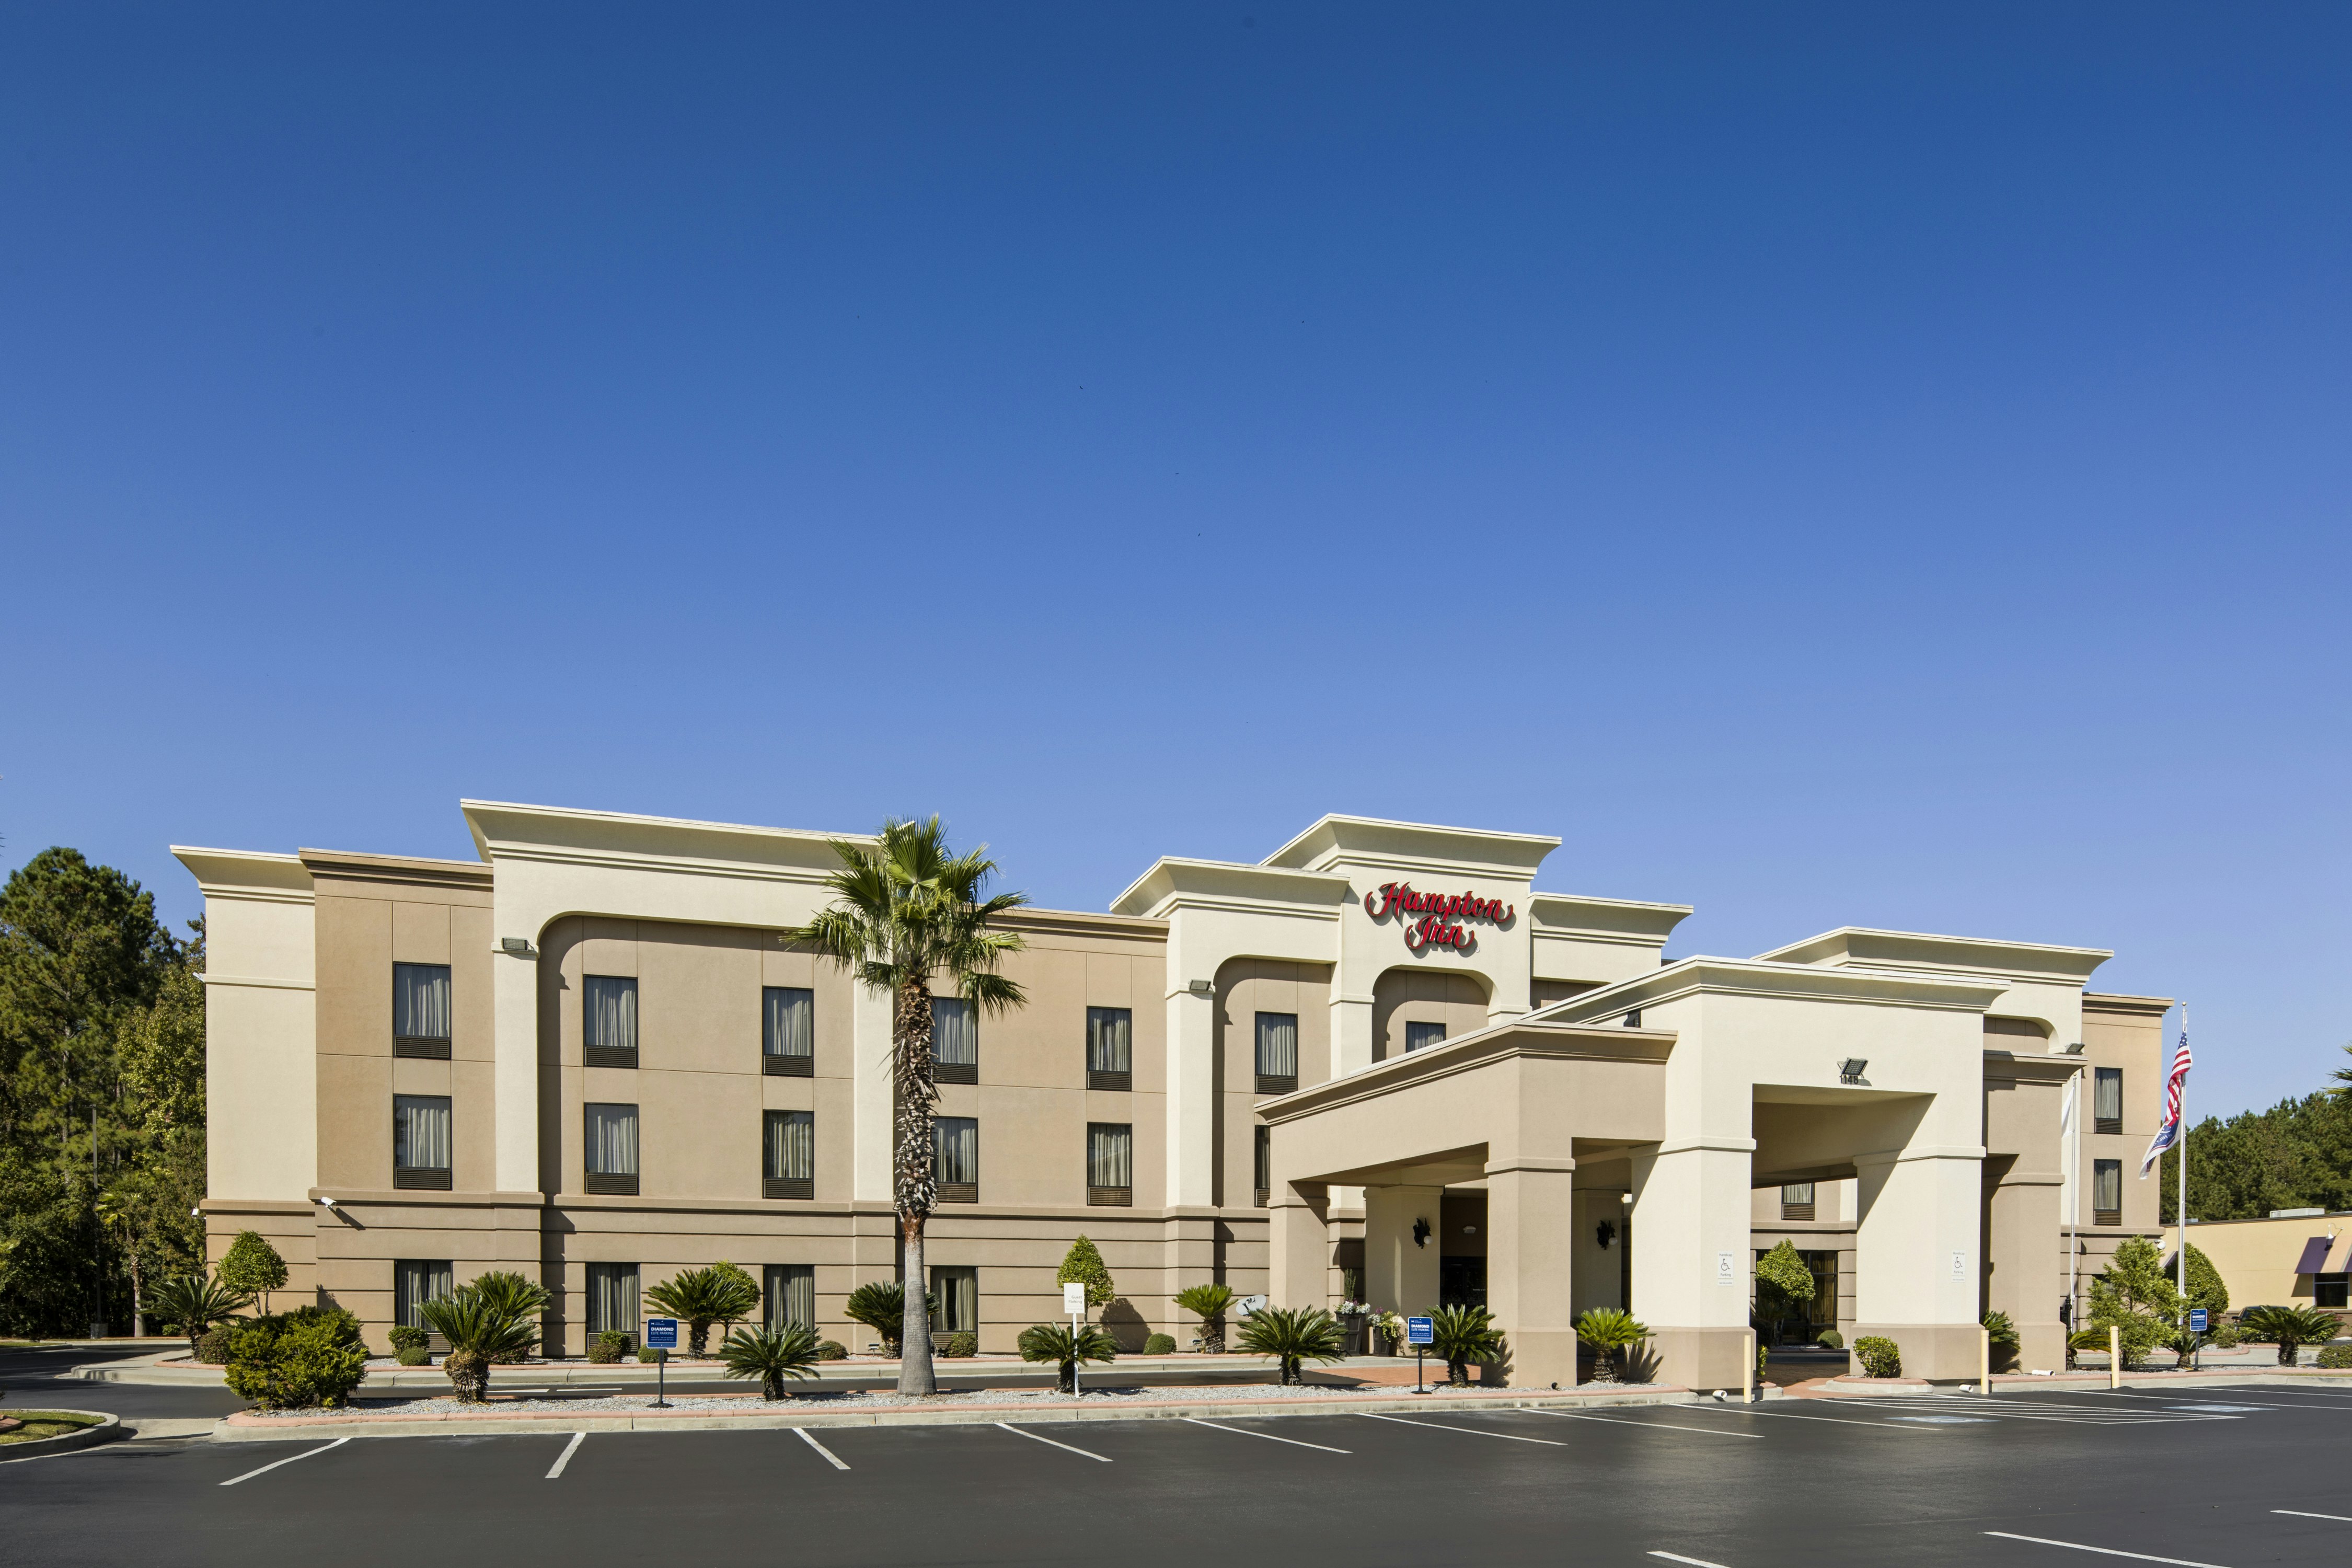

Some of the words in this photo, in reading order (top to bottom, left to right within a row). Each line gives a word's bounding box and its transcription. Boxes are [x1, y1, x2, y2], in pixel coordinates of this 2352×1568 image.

[1365, 881, 1513, 923] Hampton
[1405, 915, 1474, 950] Inn
[1839, 1074, 1859, 1085] 1148
